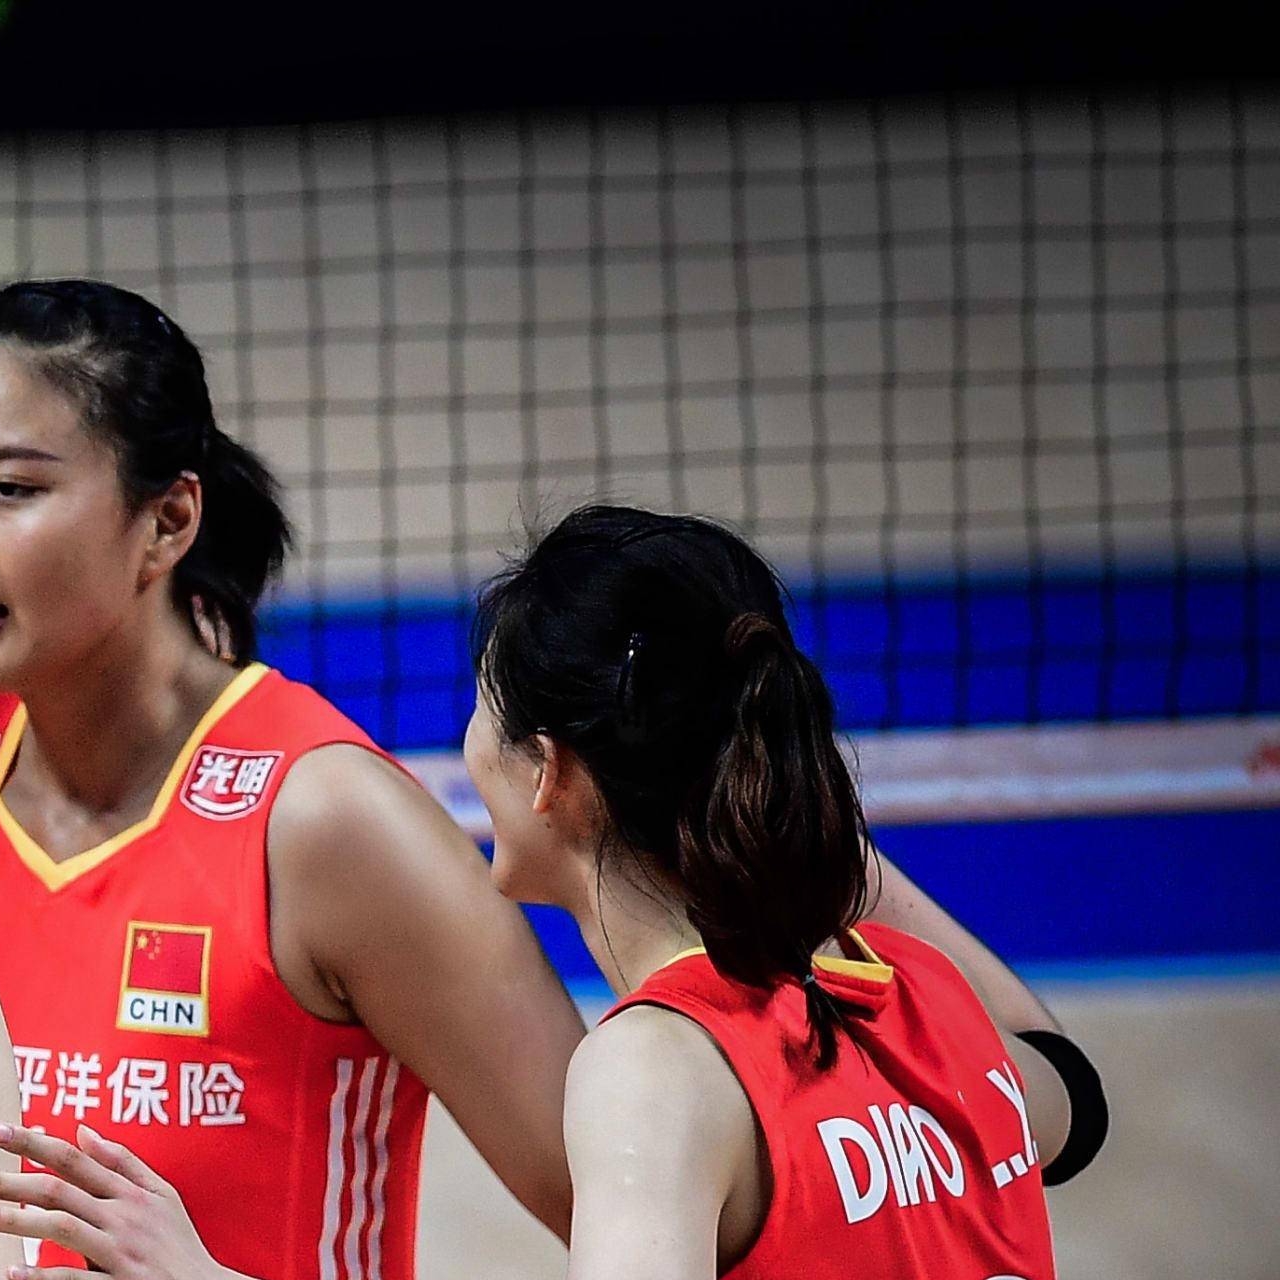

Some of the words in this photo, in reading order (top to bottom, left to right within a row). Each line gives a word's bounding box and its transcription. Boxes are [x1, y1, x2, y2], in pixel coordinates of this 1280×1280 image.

[191, 753, 274, 795] 光明
[130, 998, 195, 1025] CHN
[816, 1102, 965, 1224] DIAO
